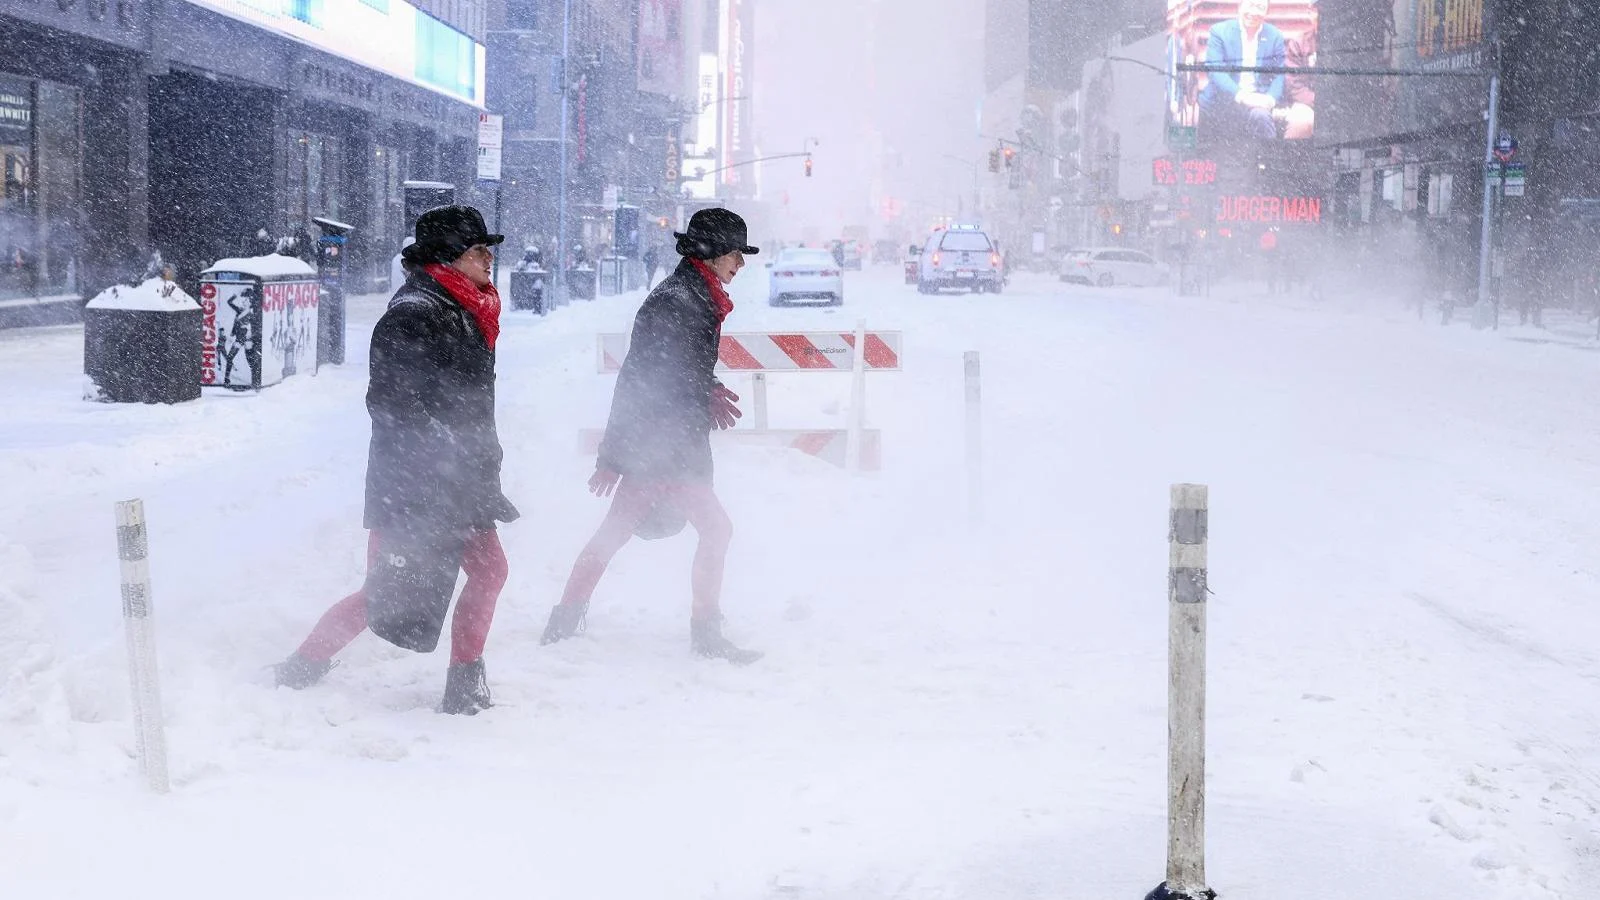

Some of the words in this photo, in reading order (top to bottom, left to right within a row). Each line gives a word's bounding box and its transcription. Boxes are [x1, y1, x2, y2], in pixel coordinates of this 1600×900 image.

[1283, 196, 1321, 223] MAN
[262, 284, 319, 312] CHICAGO
[200, 283, 216, 384] CHICAGO
